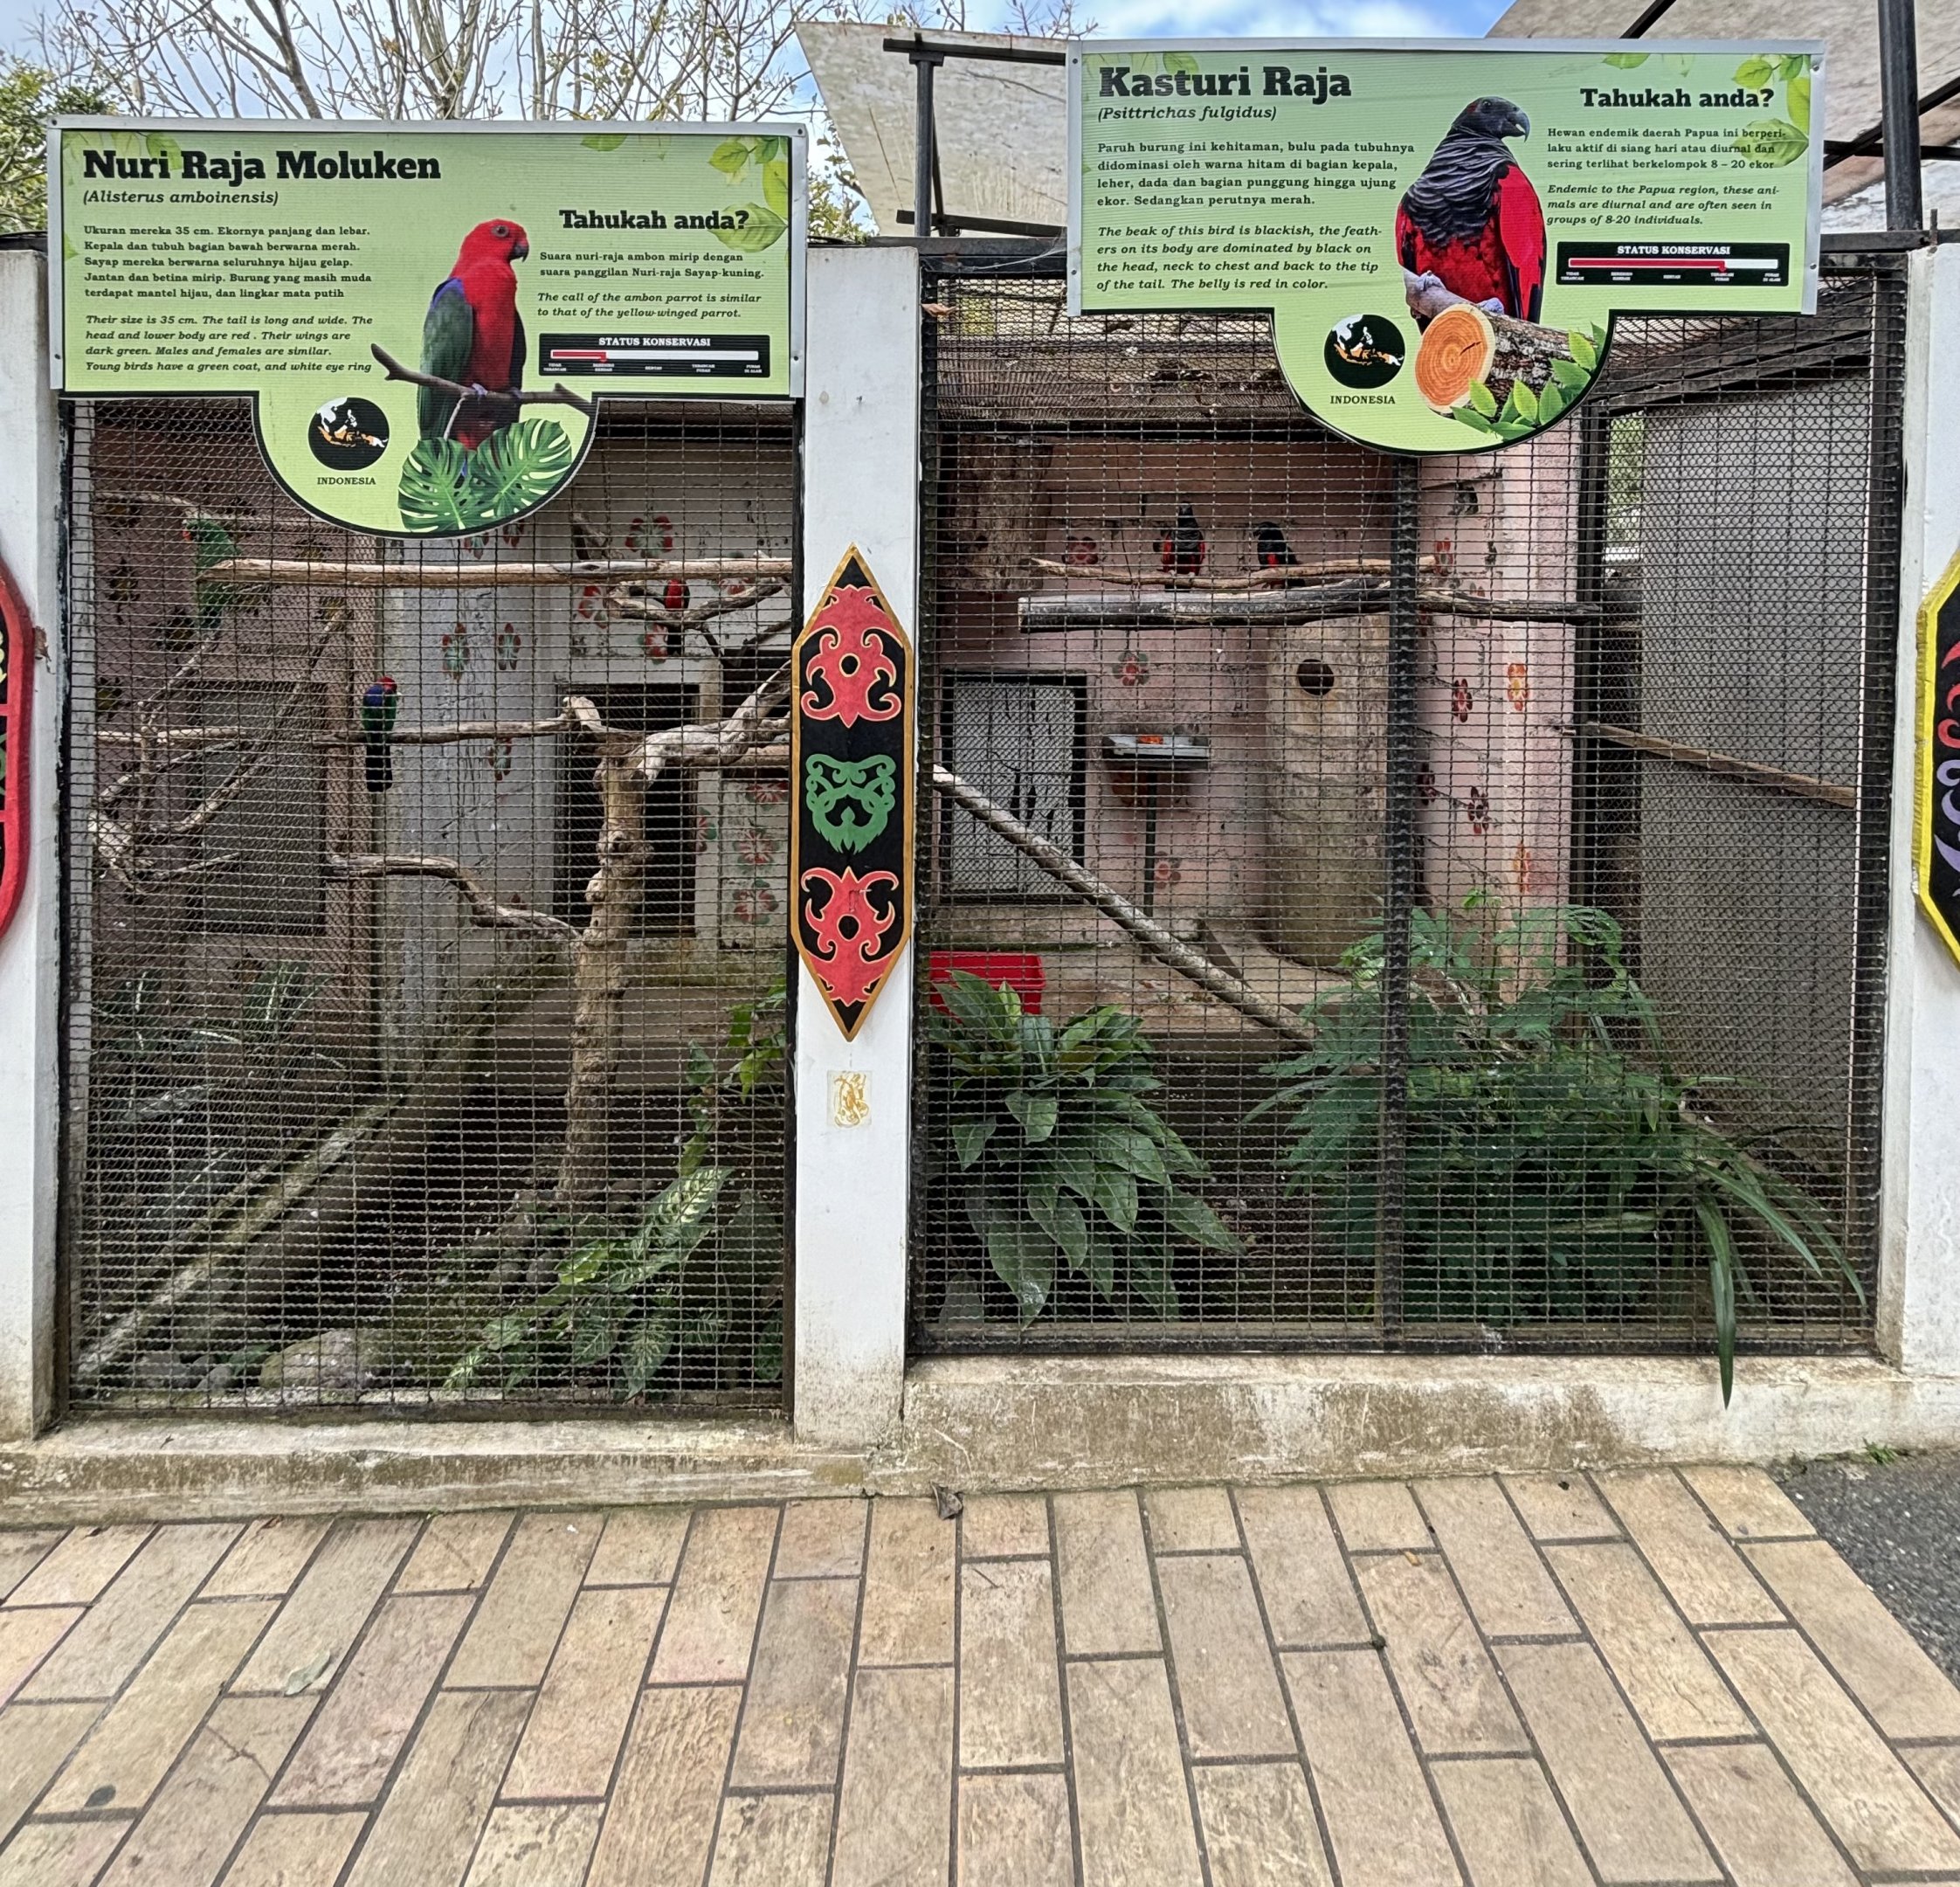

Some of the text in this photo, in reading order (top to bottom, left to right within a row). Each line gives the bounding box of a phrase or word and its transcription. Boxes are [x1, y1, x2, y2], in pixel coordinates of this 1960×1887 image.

[1099, 65, 1352, 105] Kasturi Raja
[1579, 87, 1774, 107] Tahukah anda?
[1097, 105, 1277, 123] (Psittrichas fulgidus)
[1548, 128, 1786, 140] Hewan endemik daerah Papua ini berperi-
[1097, 141, 1415, 155] Paruh burung ini kehitaman, bulu pada tubuhnya
[82, 149, 441, 187] Nuri Raja Moluken
[1097, 160, 1169, 170] didominasi
[1172, 159, 1200, 169] oleh
[1247, 159, 1286, 169] hitam
[1289, 159, 1302, 169] di
[1306, 159, 1348, 172] bagian
[1352, 159, 1398, 172] kepala,
[1547, 158, 1583, 170] sering
[1585, 159, 1629, 168] terlihat
[1632, 159, 1708, 170] berkelompok
[1710, 159, 1718, 169] 8
[1730, 159, 1746, 169] 20
[1749, 159, 1774, 169] ekor
[1097, 176, 1397, 190] leher, dada dan bagian punggung hingga ujung
[1547, 184, 1779, 196] Endemic to the Papua region, these ani-
[83, 190, 279, 206] (Alisterus amboinensis)
[1097, 194, 1315, 207] ekor. Sedangkan perutnya merah.
[1547, 199, 1576, 209] mals
[1601, 199, 1646, 209] diurnal
[1648, 199, 1672, 209] and
[1697, 200, 1728, 211] often
[1760, 200, 1771, 210] in
[558, 209, 749, 230] Tahukah anda?
[1546, 214, 1702, 226] groups of 8-20 individuals.
[83, 225, 126, 234] Ukuran
[129, 225, 172, 235] mereka
[175, 225, 190, 235] 35
[217, 226, 265, 238] Ekornya
[267, 226, 312, 238] panjang
[314, 226, 335, 235] dan
[339, 225, 370, 235] lebar.
[1098, 225, 1382, 238] The beak of this bird is blackish, the feath-
[1617, 245, 1730, 255] STATUS KONSERVASI
[540, 251, 743, 264] Suara nuri-raja ambon mirip dengan
[84, 272, 372, 284] Jantan dan betina mirip. Burung yang masih muda
[573, 266, 628, 279] panggilan
[631, 267, 681, 279] Nuri-raja
[684, 267, 764, 280] Sayap-kuning.
[1096, 278, 1328, 292] of the tail. The belly is red in color.
[537, 292, 762, 304] The call of the ambon parrot is similar
[86, 314, 118, 324] Their
[120, 314, 143, 324] size
[146, 314, 156, 324] is
[159, 315, 175, 324] 35
[202, 315, 224, 324] The
[226, 315, 247, 324] tail
[250, 315, 260, 324] is
[264, 315, 289, 327] long
[292, 315, 314, 324] and
[317, 315, 347, 324] wide.
[351, 315, 373, 324] The
[598, 337, 710, 346] STATUS KONSERVASI
[86, 362, 121, 372] Young
[123, 361, 153, 370] birds
[156, 362, 183, 370] have
[197, 363, 229, 373] green
[232, 363, 260, 372] coat,
[264, 362, 287, 370] and
[290, 362, 322, 370] white
[325, 363, 345, 373] eye
[347, 362, 372, 373] ring
[1329, 395, 1396, 404] INDONESIA
[316, 476, 376, 485] INDONESIA
